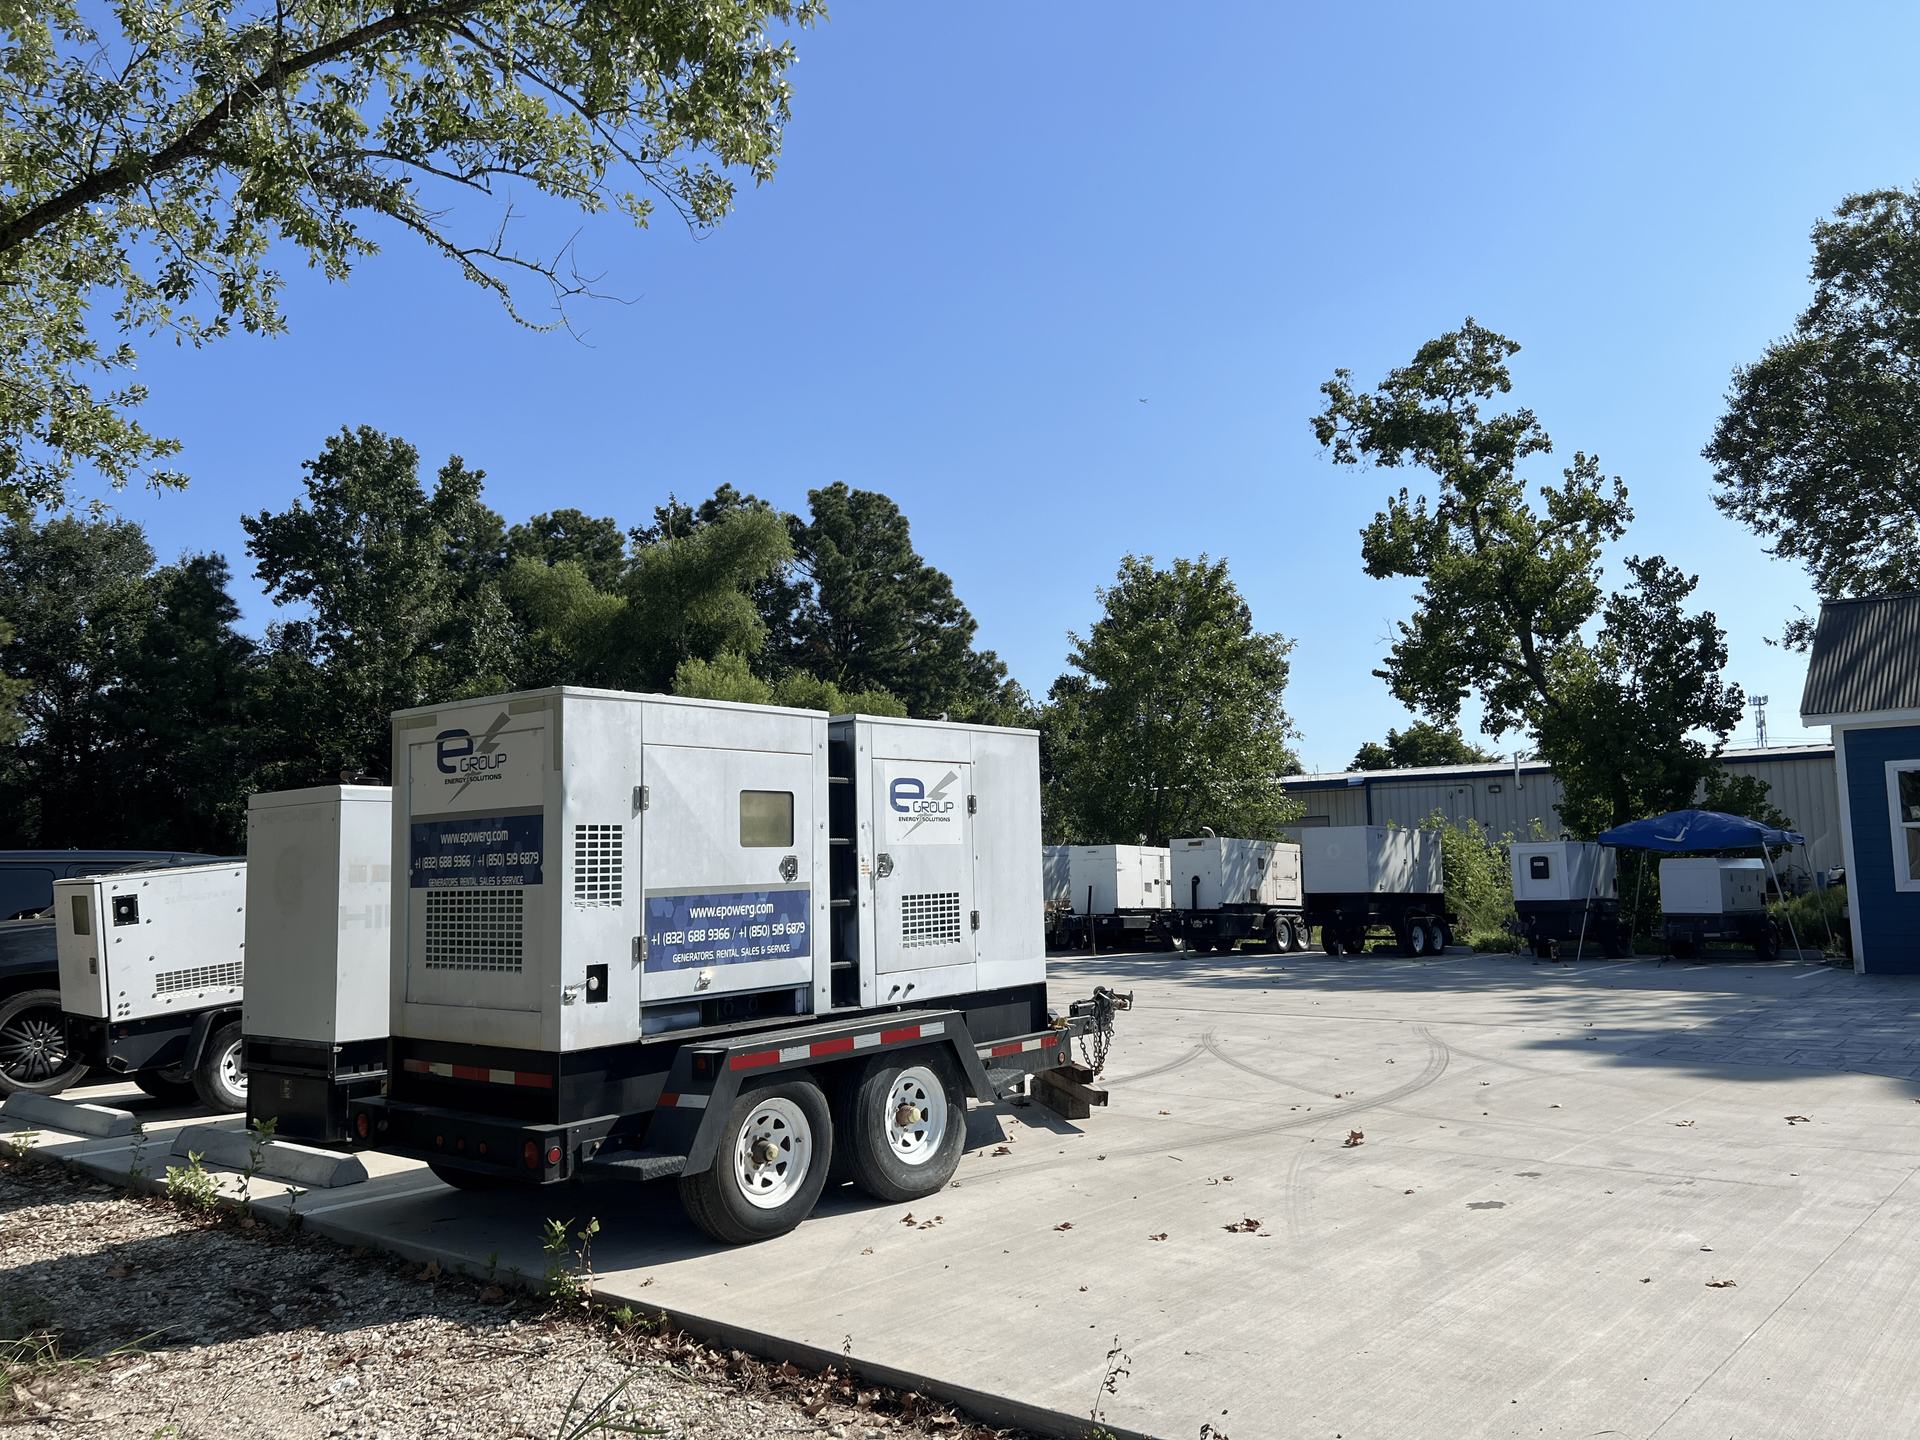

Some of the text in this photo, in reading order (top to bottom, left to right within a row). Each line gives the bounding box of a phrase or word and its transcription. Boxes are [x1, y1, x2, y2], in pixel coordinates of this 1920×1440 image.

[460, 753, 507, 772] GROUP
[444, 773, 502, 785] ENERGY SOLUTIONS
[913, 801, 954, 813] GROUP
[440, 830, 508, 846] www.epowerg.com
[422, 856, 438, 870] (832)
[439, 855, 452, 868] 688
[453, 854, 471, 868] 9366
[486, 853, 505, 867] (850)
[506, 852, 518, 866] 519
[520, 851, 539, 864] 6879
[460, 877, 478, 886] RENTAL
[479, 876, 496, 886] SALES
[496, 876, 500, 885] &
[502, 875, 524, 885] SERVICE
[340, 904, 389, 930] HI
[690, 903, 774, 919] www.epowerg.com
[662, 931, 686, 946] (832)
[687, 929, 706, 942] 688
[708, 928, 730, 941] 9366
[749, 924, 770, 939] (850)
[772, 923, 784, 936] 519
[786, 922, 805, 934] 6879
[716, 948, 739, 959] RENTAL
[741, 947, 759, 957] SALES
[761, 945, 765, 955] &
[767, 943, 790, 954] SERVICE
